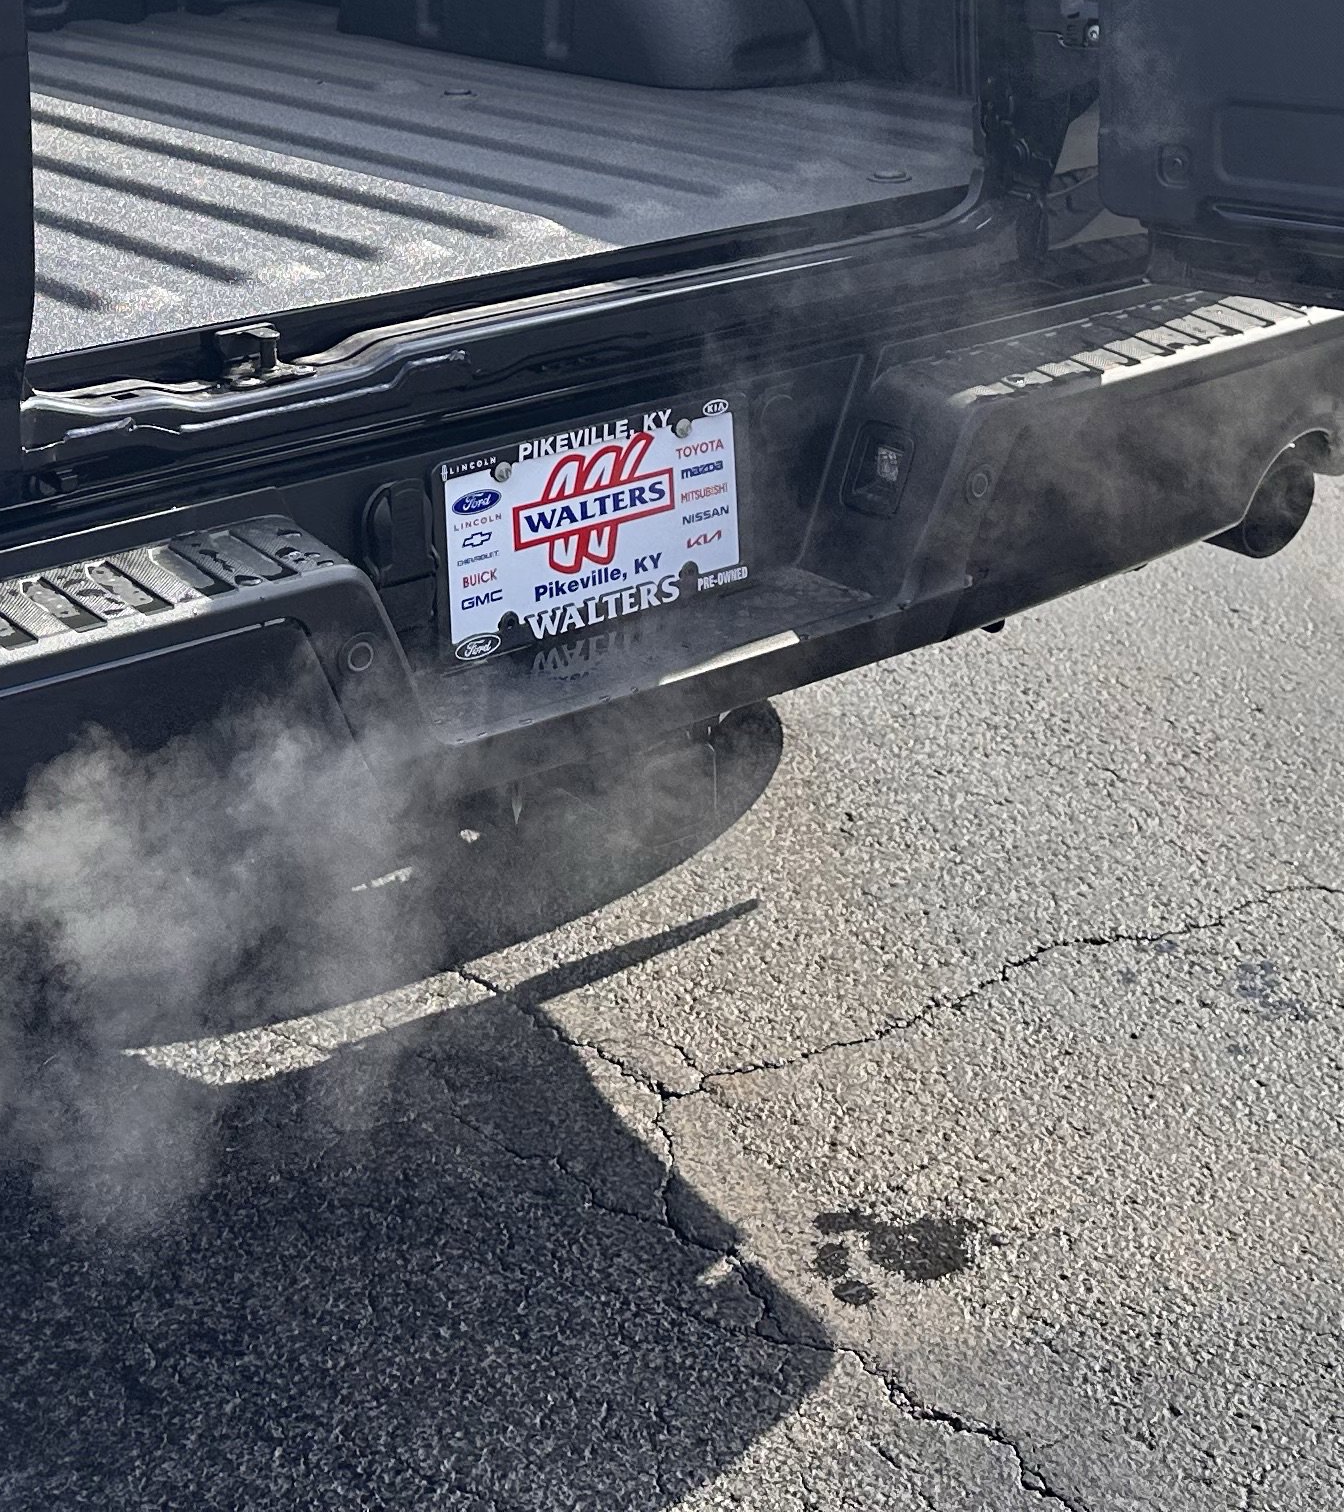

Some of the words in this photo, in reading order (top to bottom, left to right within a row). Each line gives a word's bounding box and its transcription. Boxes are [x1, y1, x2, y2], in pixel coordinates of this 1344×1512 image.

[707, 402, 725, 414] KIA
[518, 418, 636, 462] PIKEVILLE,
[643, 408, 672, 432] KY
[676, 439, 724, 459] TOYOTA
[449, 456, 497, 475] LINCOLN
[462, 492, 492, 511] Ford
[681, 482, 728, 503] MITSUBISHI
[524, 480, 666, 534] WALTERS
[682, 505, 730, 525] NISSAN
[453, 513, 502, 532] LINCOLN
[462, 568, 498, 589] BUICK
[534, 567, 628, 603] Pikeville,
[634, 552, 663, 575] KY
[697, 566, 748, 591] PRE-OWNED
[461, 589, 504, 610] GMC
[527, 575, 680, 640] WALTERS
[464, 639, 492, 658] Ford
